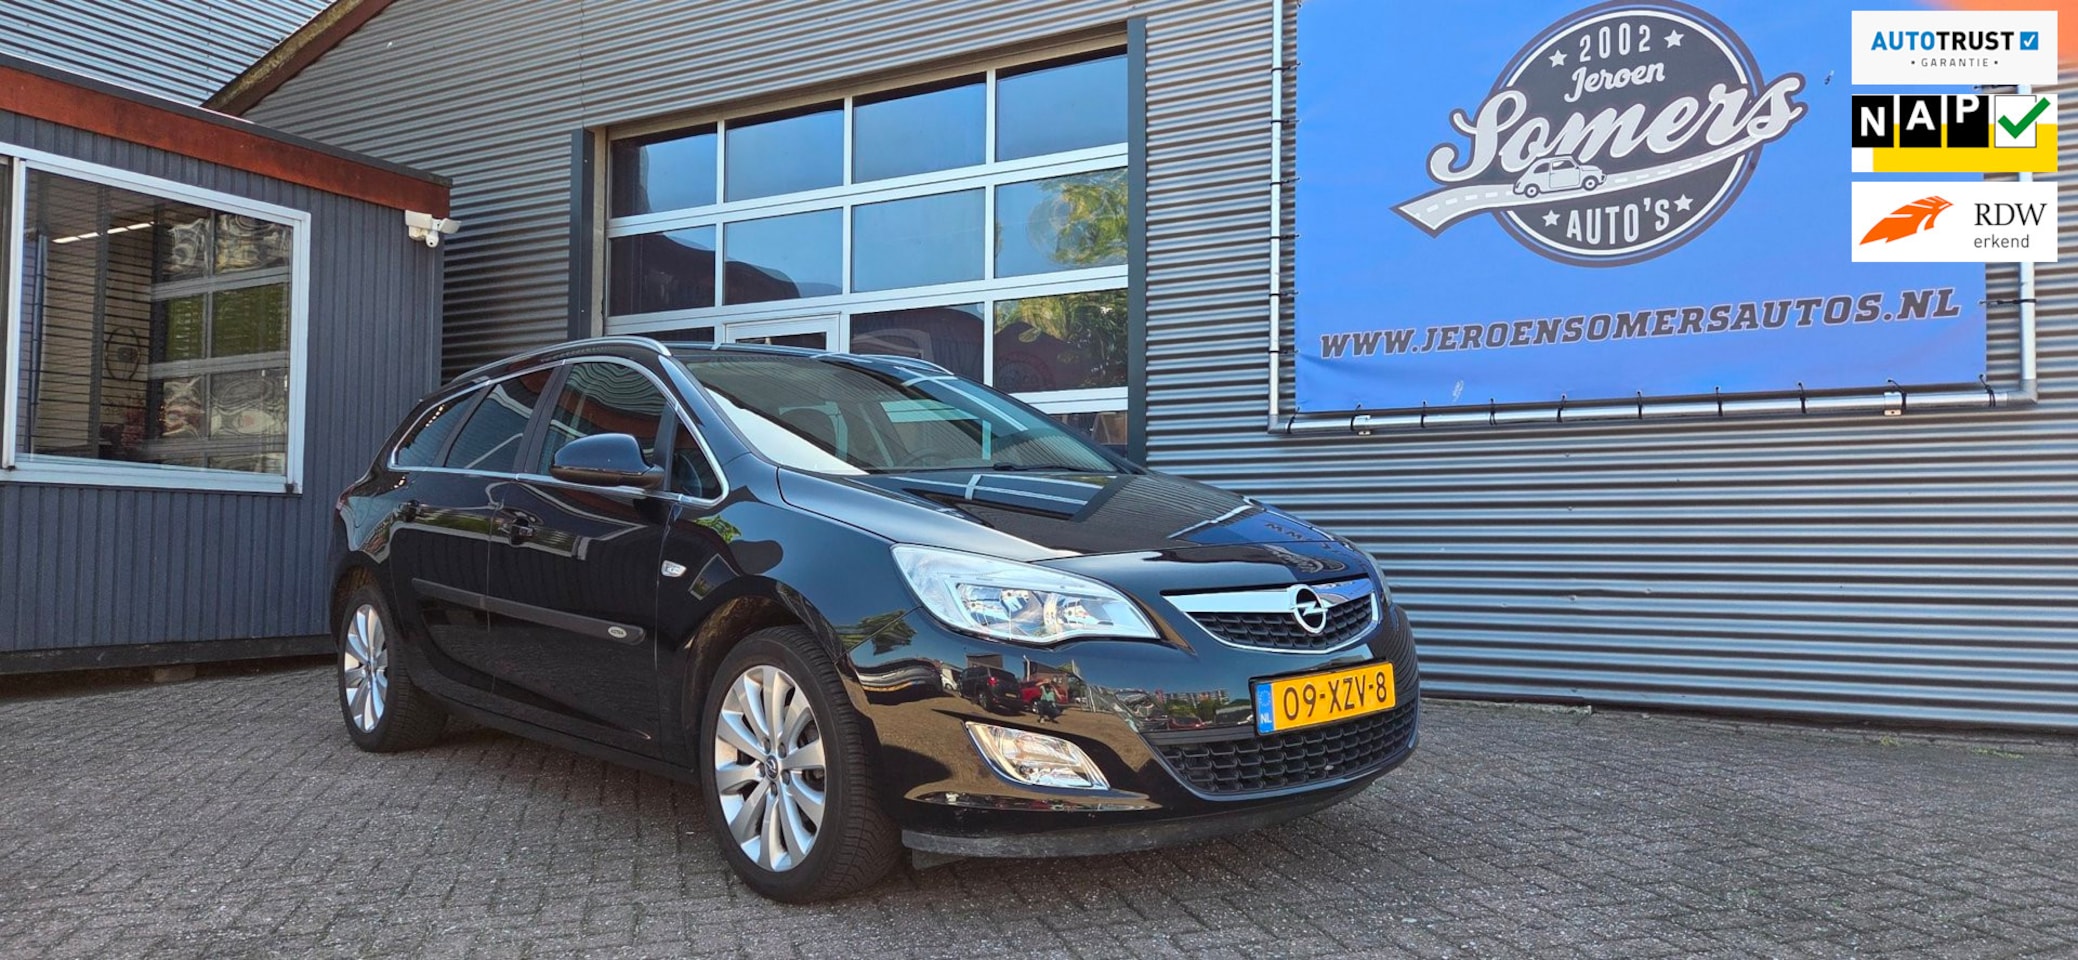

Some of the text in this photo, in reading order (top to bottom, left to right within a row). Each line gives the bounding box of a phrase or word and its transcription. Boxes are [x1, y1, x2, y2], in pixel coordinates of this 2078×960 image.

[1579, 23, 1651, 62] 2002
[1565, 62, 1665, 103] Jeroen
[1430, 77, 1803, 182] Somers
[1566, 197, 1671, 245] AUTO'S
[1319, 287, 1961, 359] WWW.JEROENSOMERSAUTOS.NL
[1260, 713, 1272, 724] NL
[1283, 671, 1387, 721] 09-XZV-8
